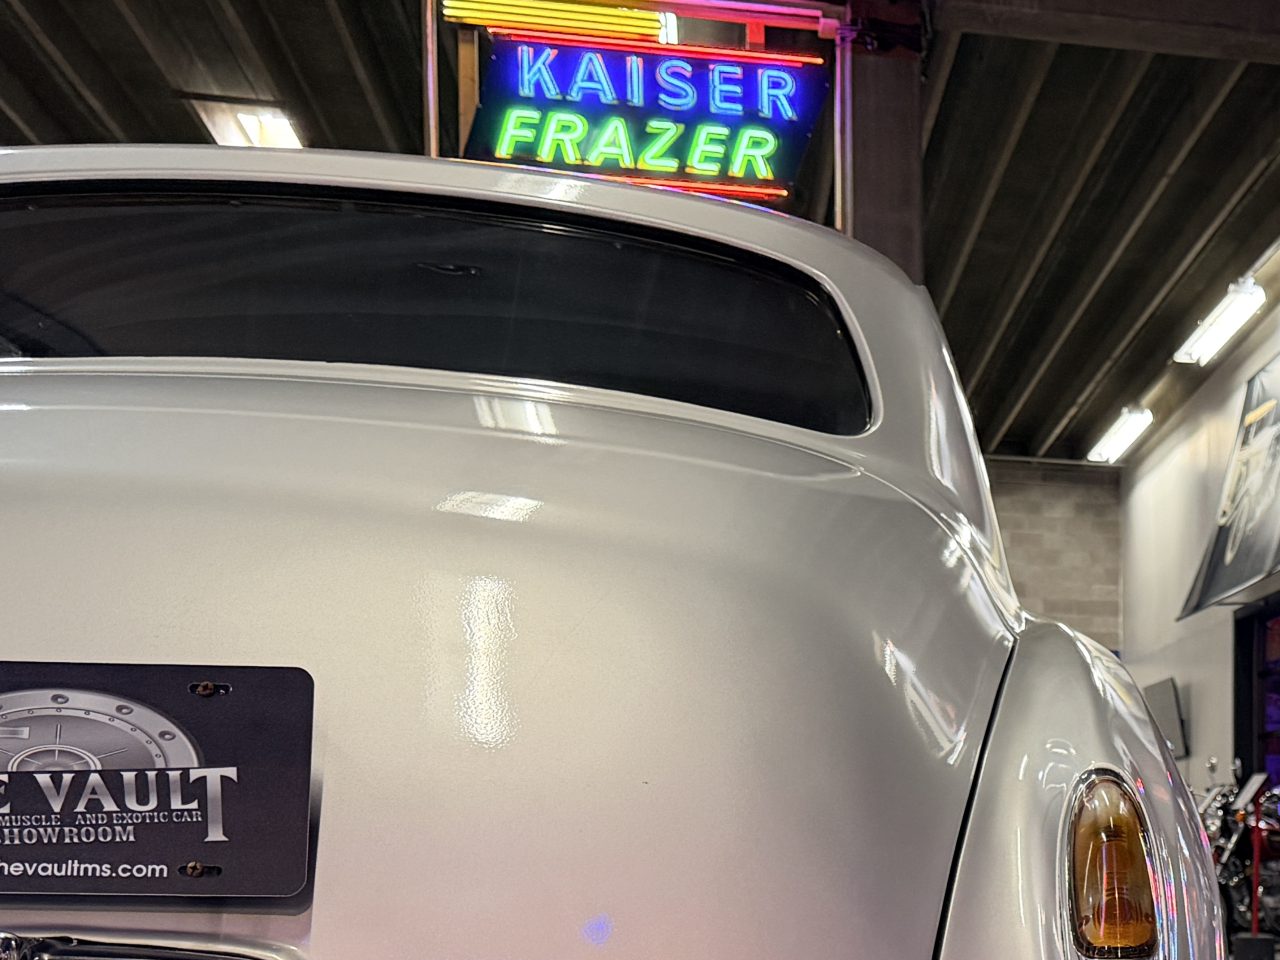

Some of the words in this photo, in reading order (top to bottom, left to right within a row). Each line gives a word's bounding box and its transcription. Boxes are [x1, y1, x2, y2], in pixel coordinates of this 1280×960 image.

[517, 44, 798, 121] KAISER
[494, 108, 778, 180] FRAZER
[0, 814, 61, 827] MUSCLE
[75, 812, 108, 825] AND
[112, 811, 169, 824] EXOTIC
[172, 810, 203, 823] CAR
[0, 826, 137, 845] HOWROOM
[33, 766, 239, 843] VAULT
